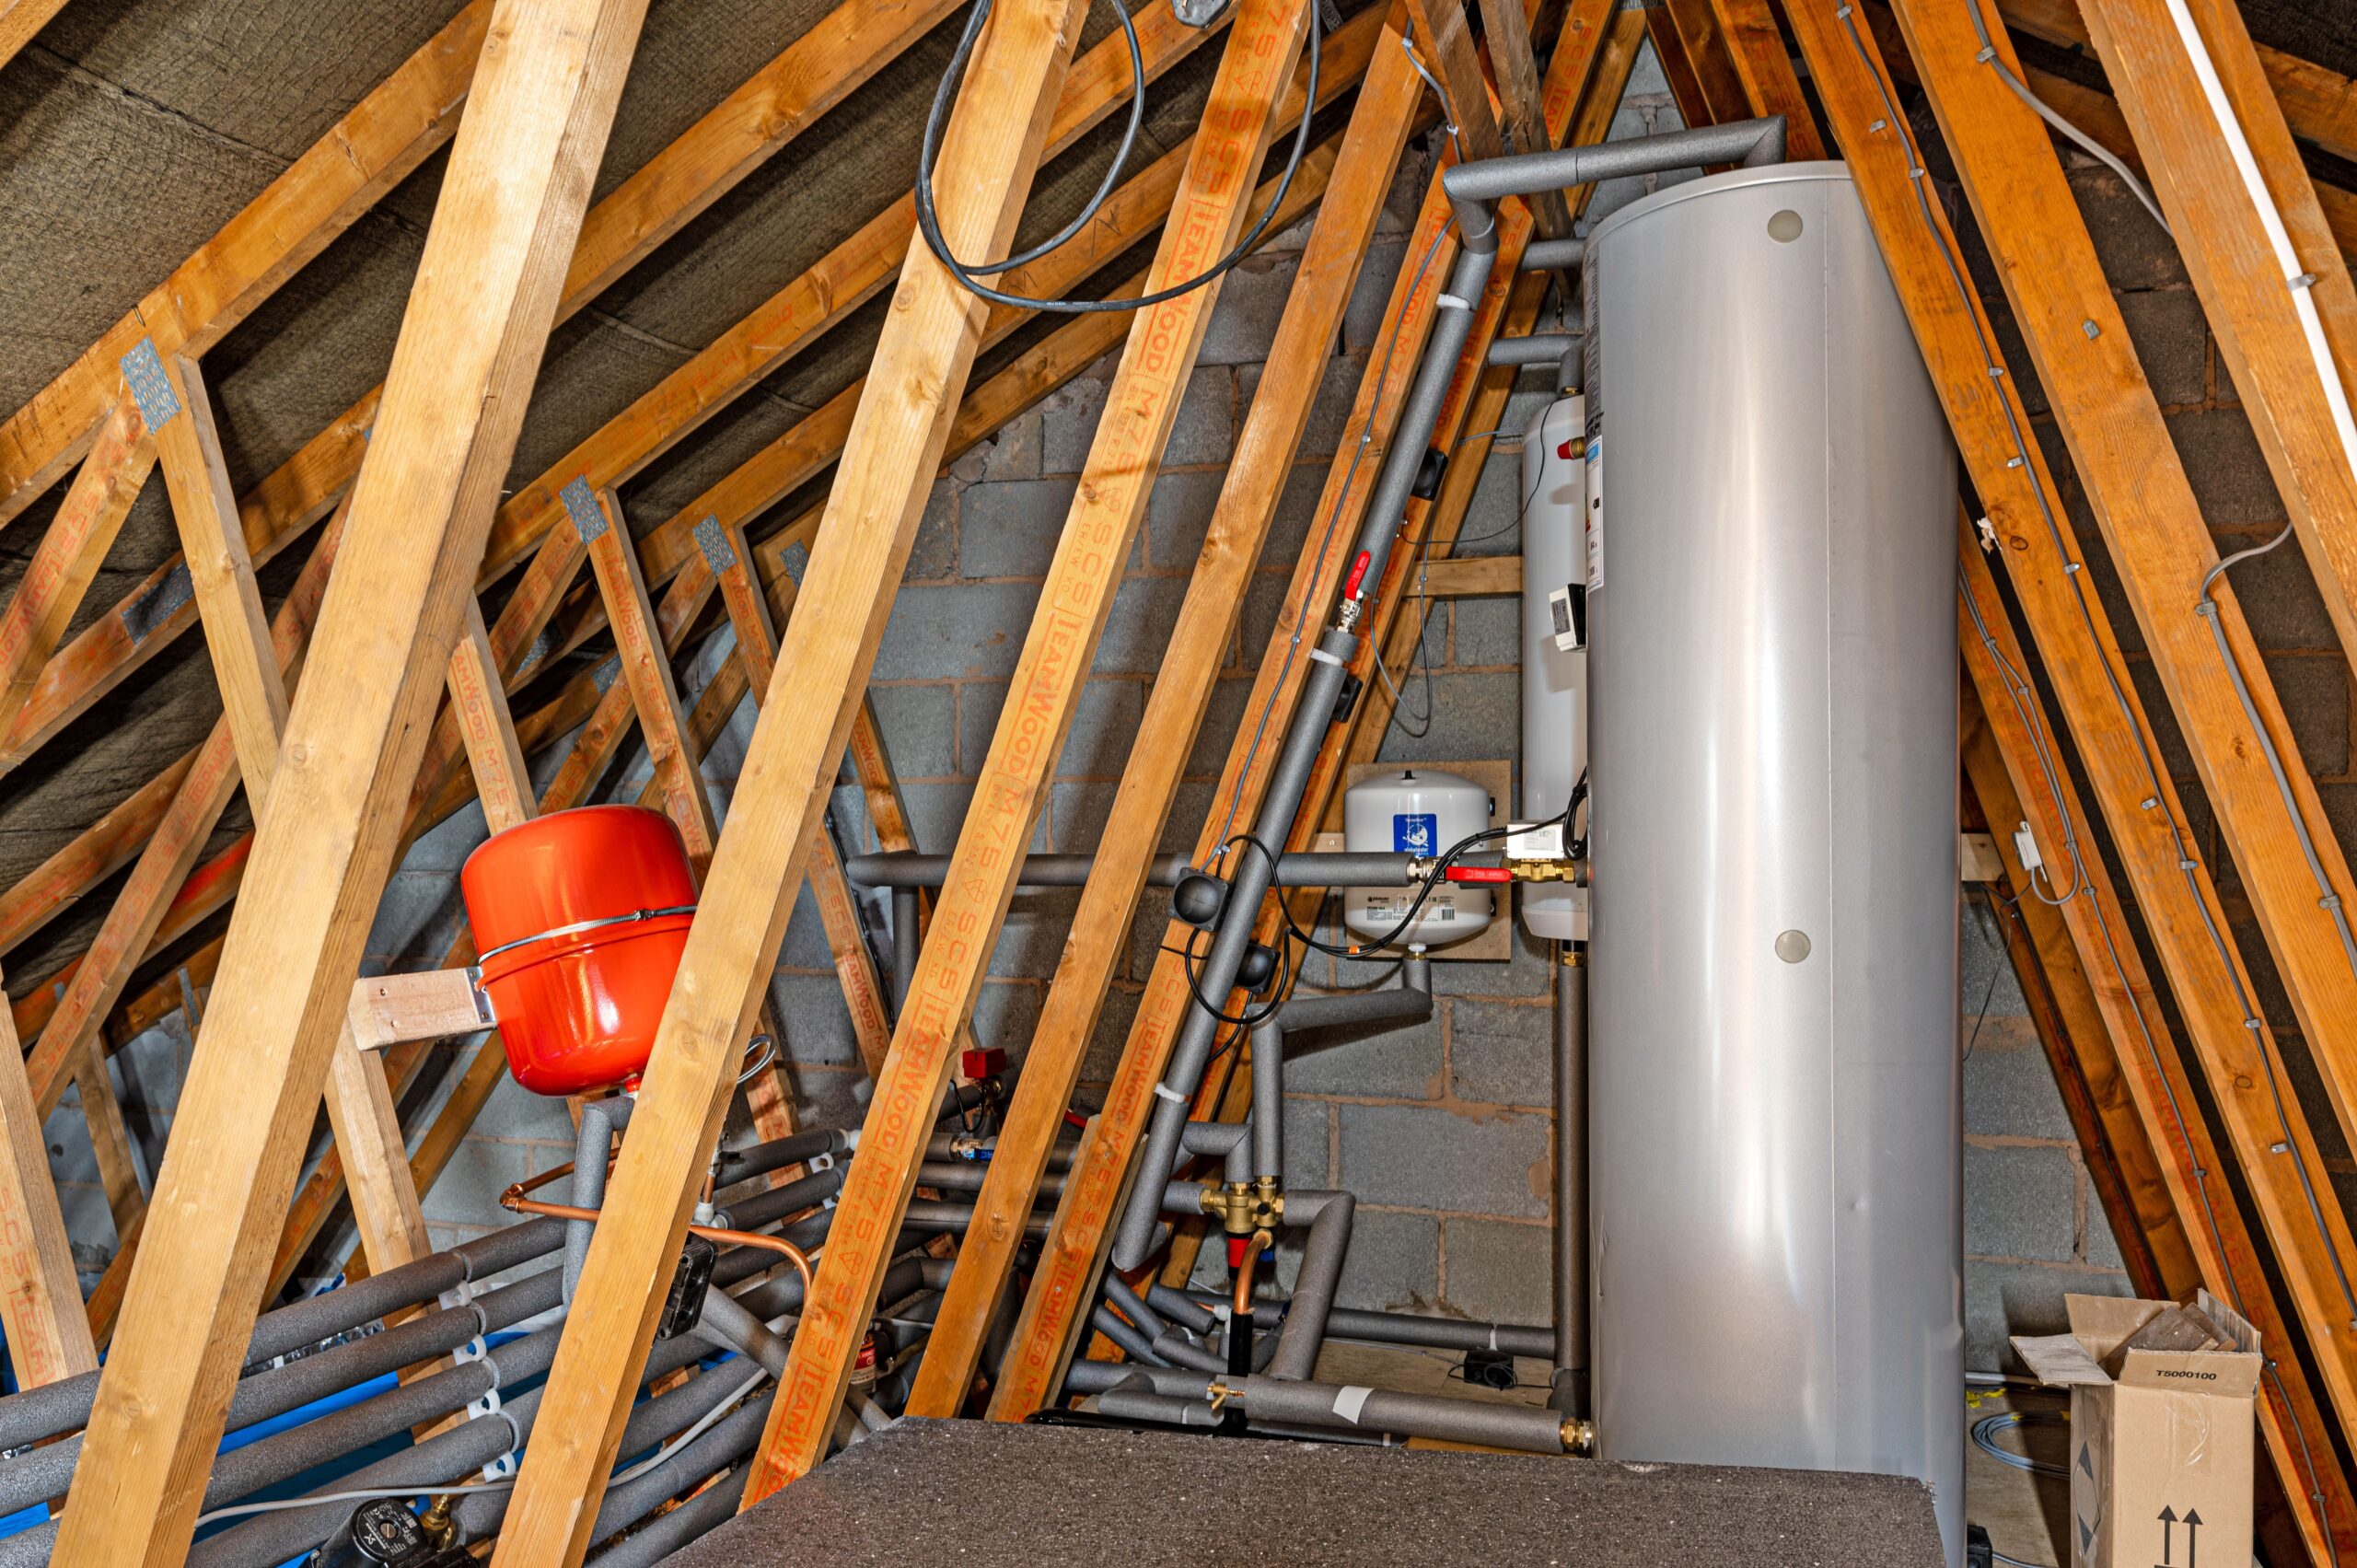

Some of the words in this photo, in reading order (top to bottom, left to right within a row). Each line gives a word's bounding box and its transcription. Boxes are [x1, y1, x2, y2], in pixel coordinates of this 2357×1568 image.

[1206, 105, 1254, 196] SC5
[1139, 205, 1222, 377] TEAMWOOD
[1113, 388, 1158, 476] M75
[1059, 575, 1073, 593] KD
[1067, 521, 1091, 566] ER/EW
[1069, 519, 1114, 606] SC5
[604, 556, 643, 648] TEAMWOOD
[447, 651, 496, 741] AMWOOD
[1004, 616, 1083, 780] TEAMWOOD
[480, 748, 513, 806] M75
[977, 786, 1021, 870] M75
[926, 961, 939, 979] KD
[934, 911, 957, 954] ER/EW
[935, 909, 979, 992] SC5
[842, 945, 880, 1030] TEAMWOOD
[876, 1000, 950, 1153] TEAMWOOD
[1115, 1018, 1167, 1125] TEAMWOOD
[853, 1161, 895, 1241] M75
[13, 1295, 59, 1386] TEAM
[812, 1280, 856, 1360] SC5
[1028, 1269, 1075, 1369] TEAMWOOD
[2155, 1369, 2217, 1380] T5000100
